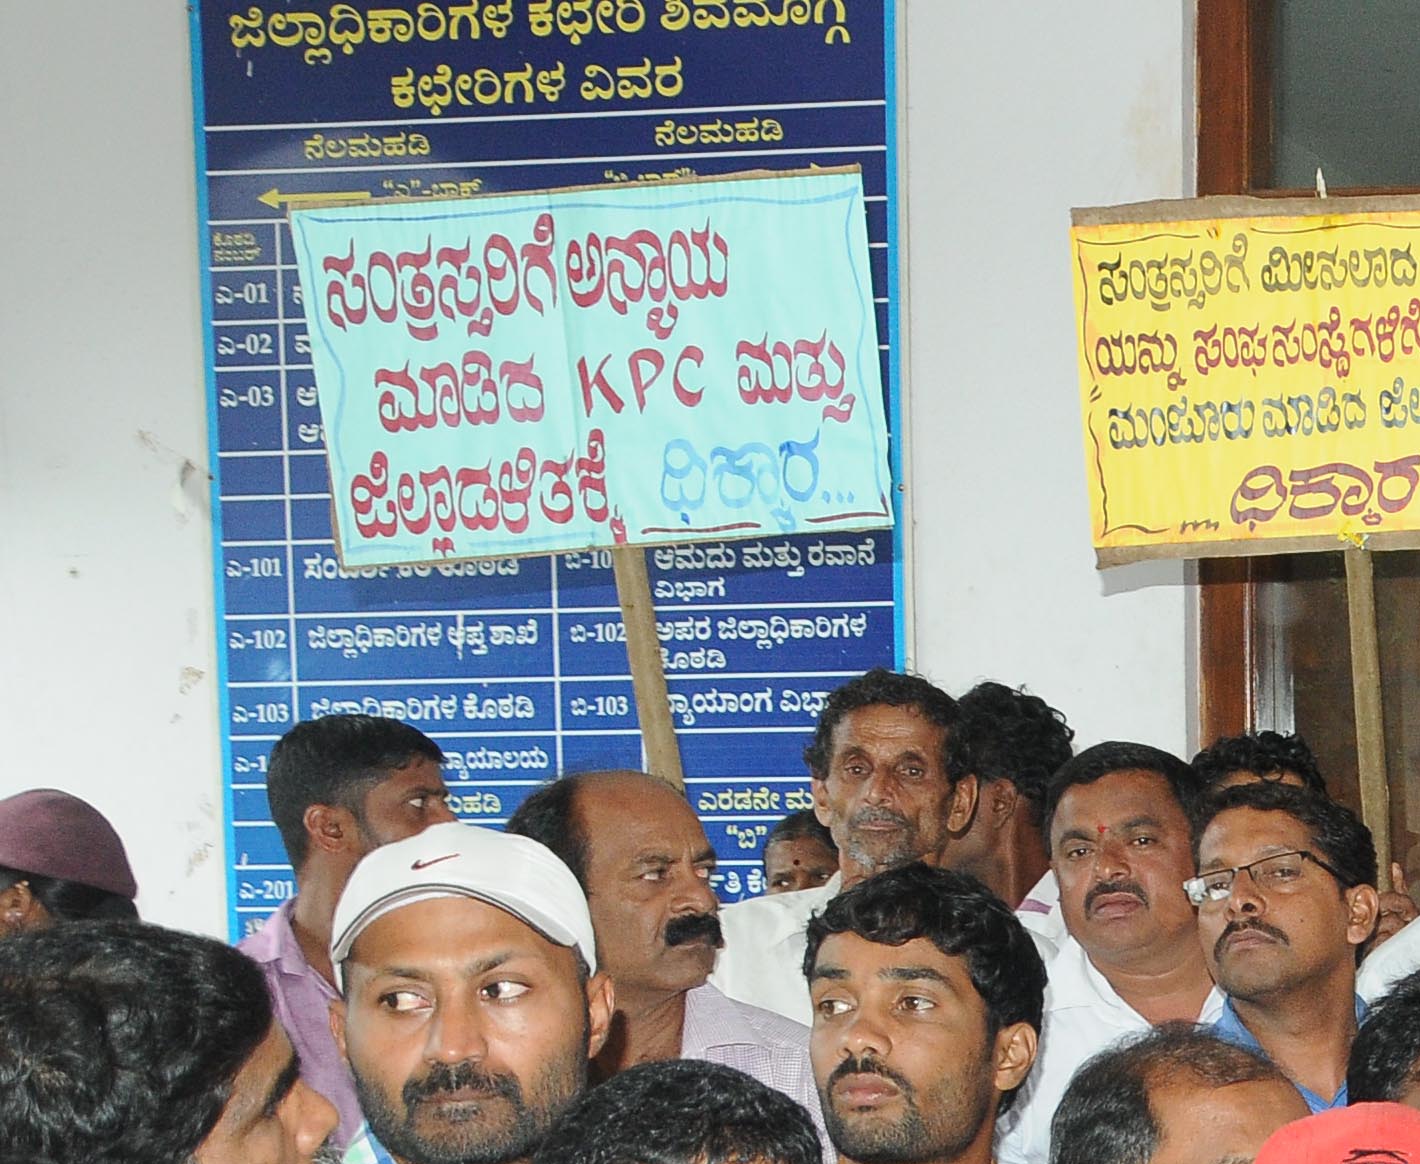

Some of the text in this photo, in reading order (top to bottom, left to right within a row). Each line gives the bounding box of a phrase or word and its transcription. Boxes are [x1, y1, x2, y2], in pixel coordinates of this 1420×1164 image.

[391, 55, 684, 116] ಕಛೇರಿಗಳ ವಿವರ
[303, 131, 431, 160] ನೆಲಮಹಡಿ
[655, 117, 784, 147] ನೆಲಮಹಡಿ
[374, 328, 856, 433] ಮಾಡಿದ KPC ಮತ್ತು
[1262, 386, 1367, 438] ಮಾಡಿದ
[742, 541, 806, 577] ಮತ್ತು
[807, 537, 876, 566] ರವಾನೆ
[654, 576, 726, 602] ವಿಭಾಗ
[308, 622, 442, 658] ಜಿಲ್ಲಾಧಿಕಾರಿಗಳ
[717, 612, 868, 650] ಜಿಲ್ಲಾಧಿಕಾರಿಗಳ
[463, 692, 535, 720] ಕೊಠಡಿ
[779, 690, 833, 719] ವಿಭಾ
[698, 787, 781, 812] ಎರಡನೇ
